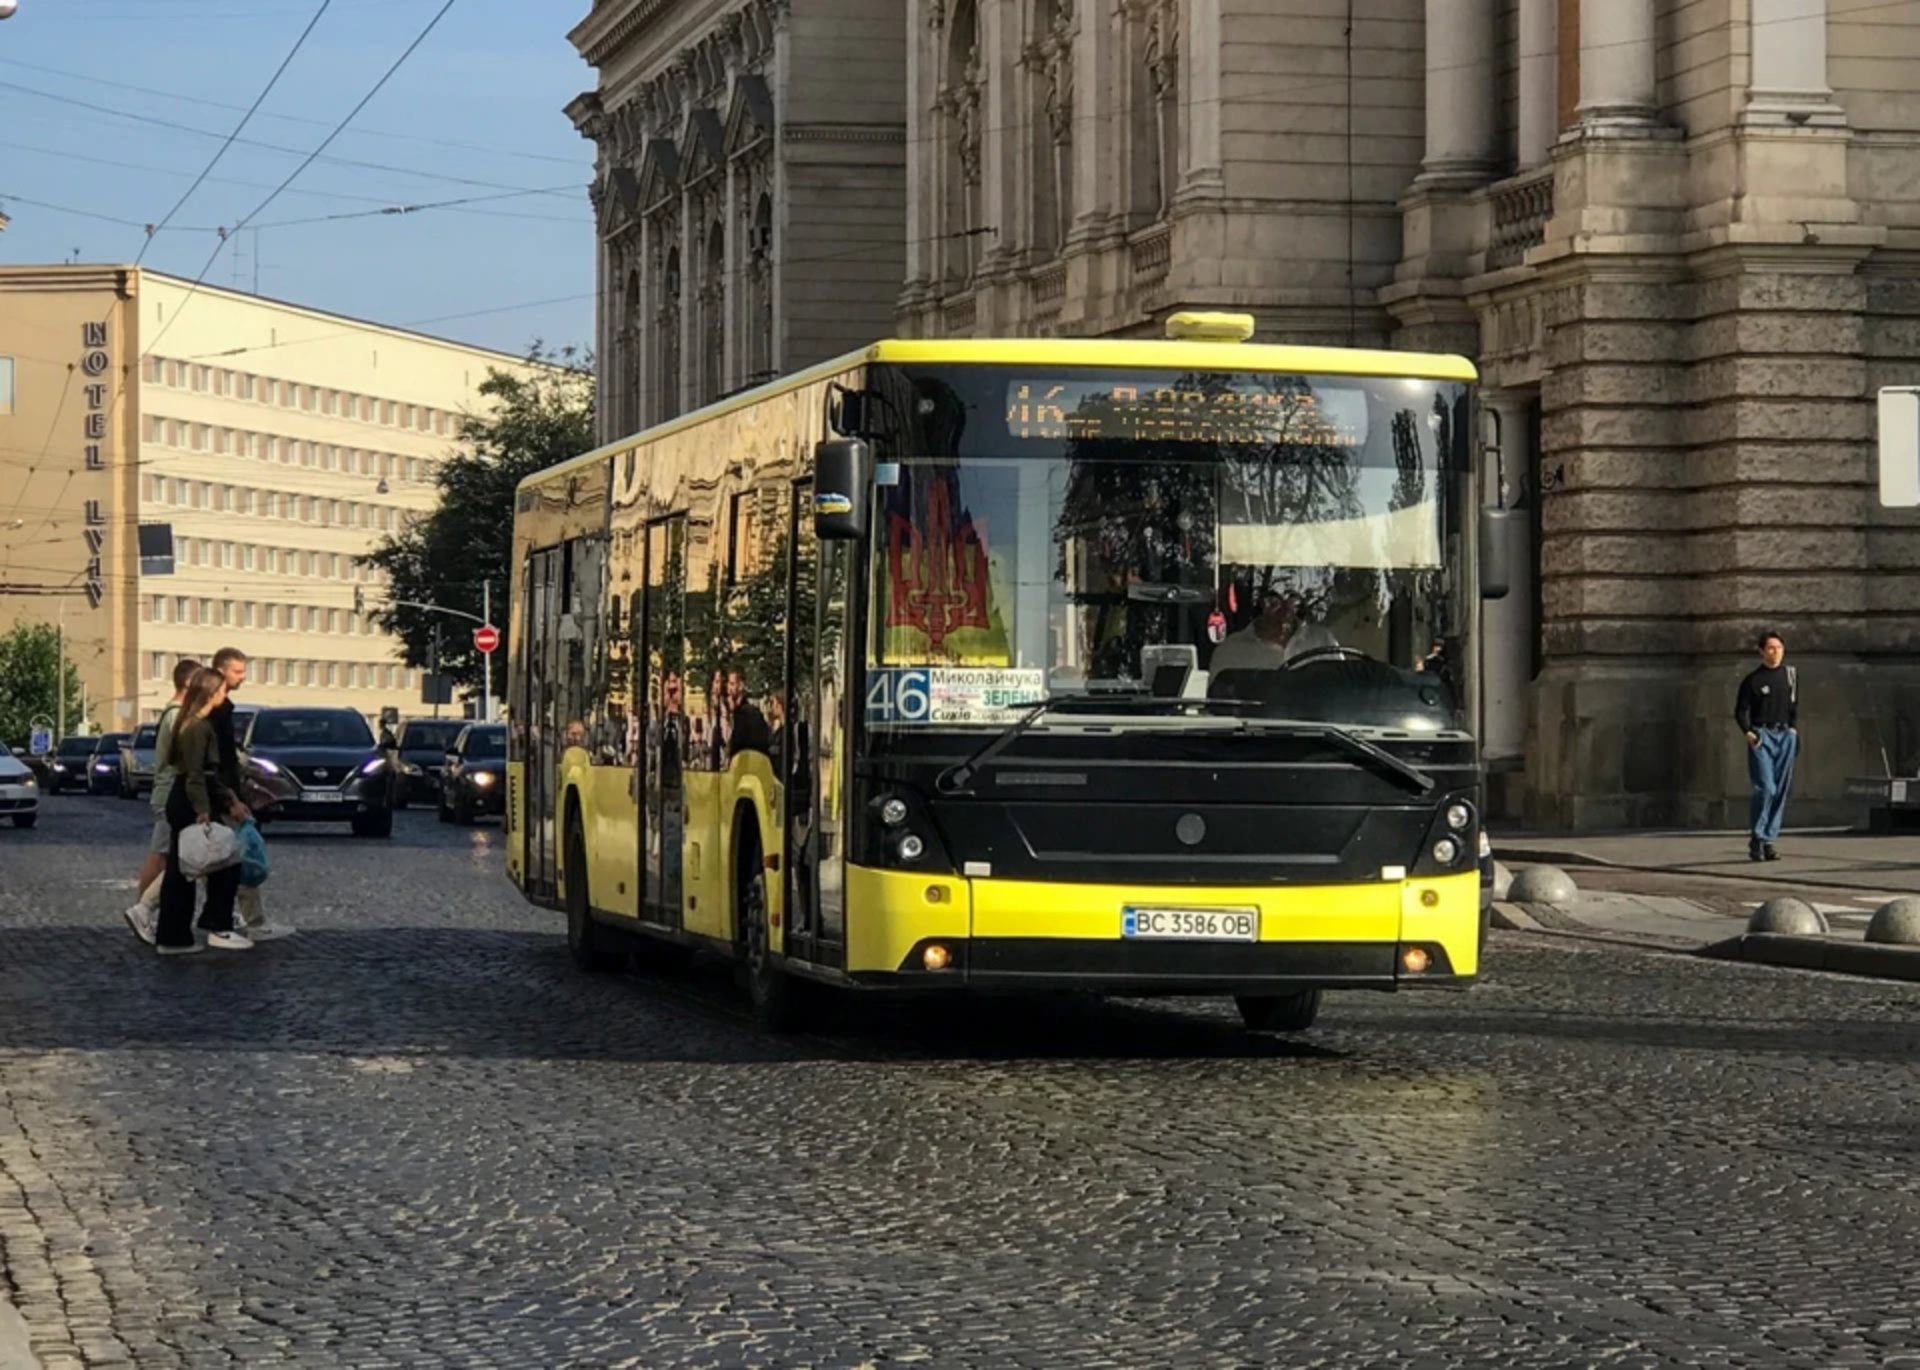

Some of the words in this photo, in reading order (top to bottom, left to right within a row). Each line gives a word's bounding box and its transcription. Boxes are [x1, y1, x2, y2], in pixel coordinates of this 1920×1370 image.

[81, 321, 108, 471] HOTEL
[82, 500, 107, 610] LVIV
[866, 671, 928, 719] 46
[931, 670, 1042, 689] Миколайчука
[1137, 912, 1165, 933] BC
[1171, 913, 1218, 935] 3586
[1222, 915, 1251, 935] OB
